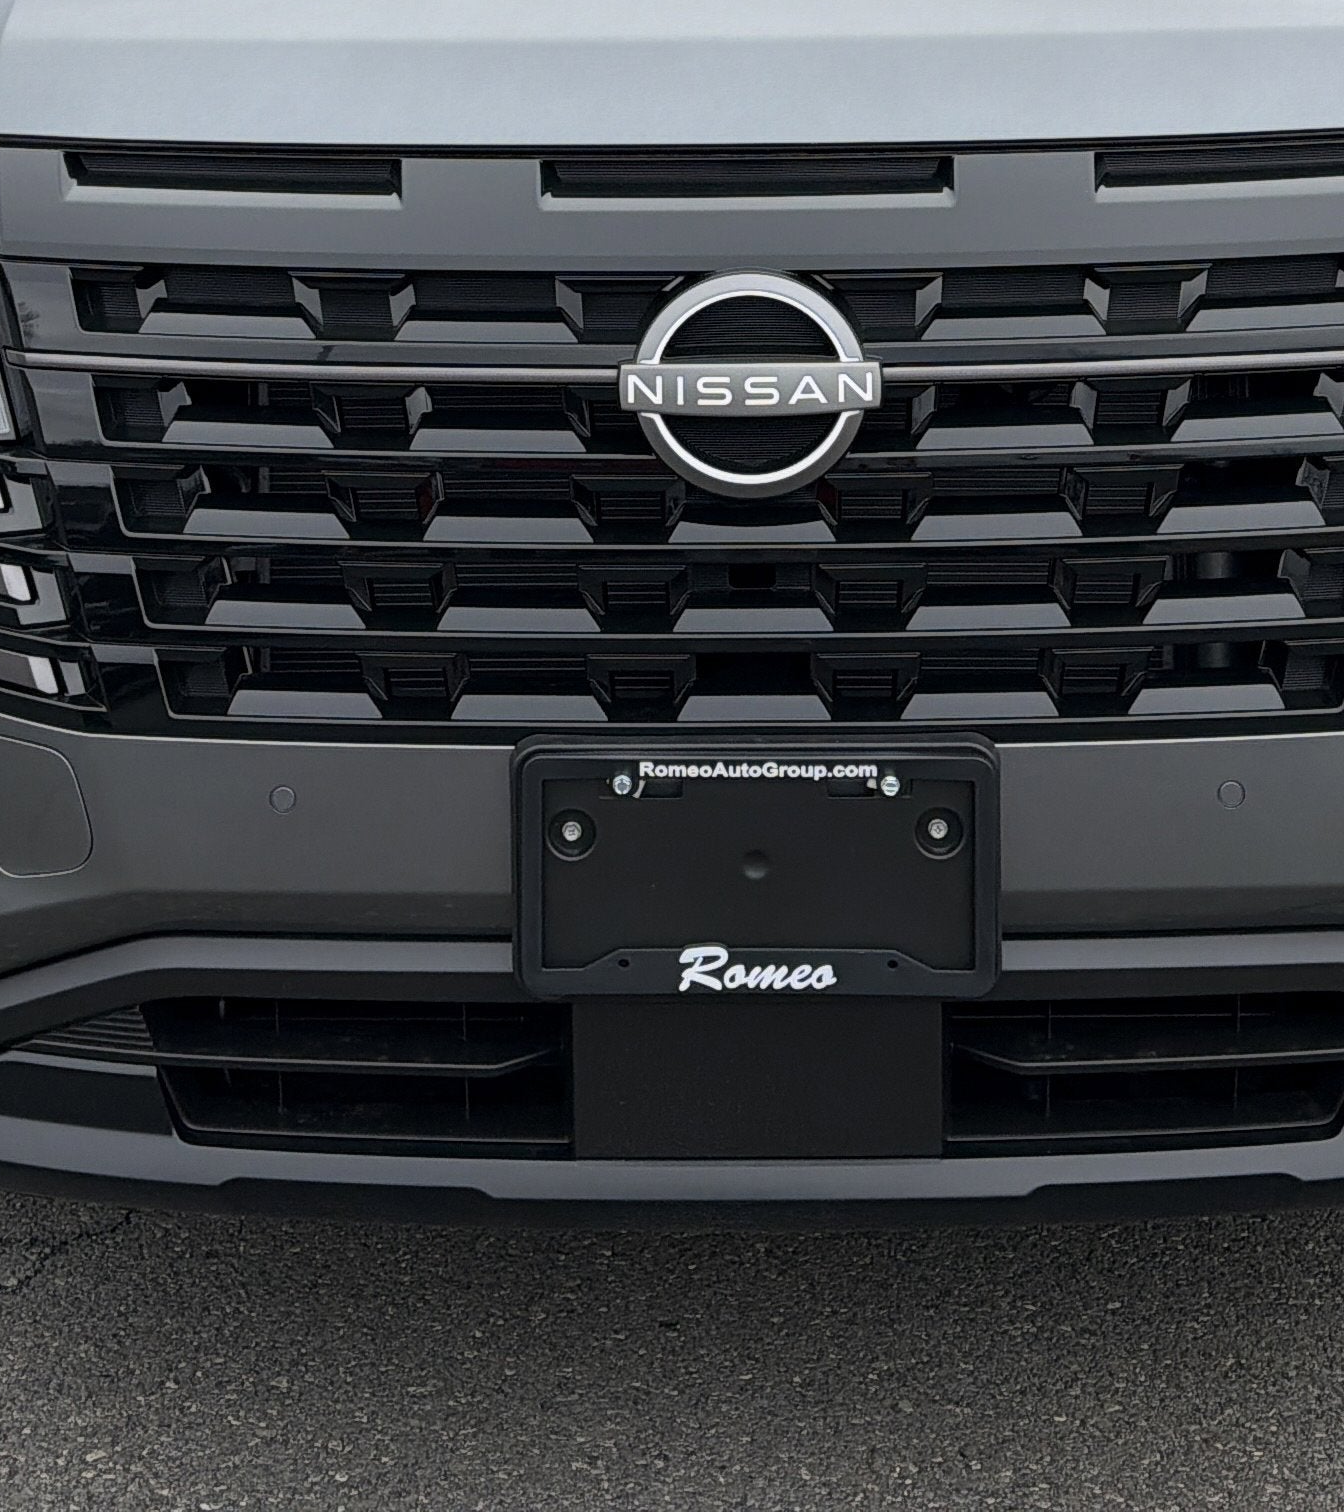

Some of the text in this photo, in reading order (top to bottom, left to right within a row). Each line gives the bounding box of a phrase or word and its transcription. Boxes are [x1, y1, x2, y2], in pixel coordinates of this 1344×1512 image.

[626, 371, 873, 406] NISSAN
[639, 761, 878, 780] RomeoAutoGroup.com
[678, 945, 837, 992] Romeo
